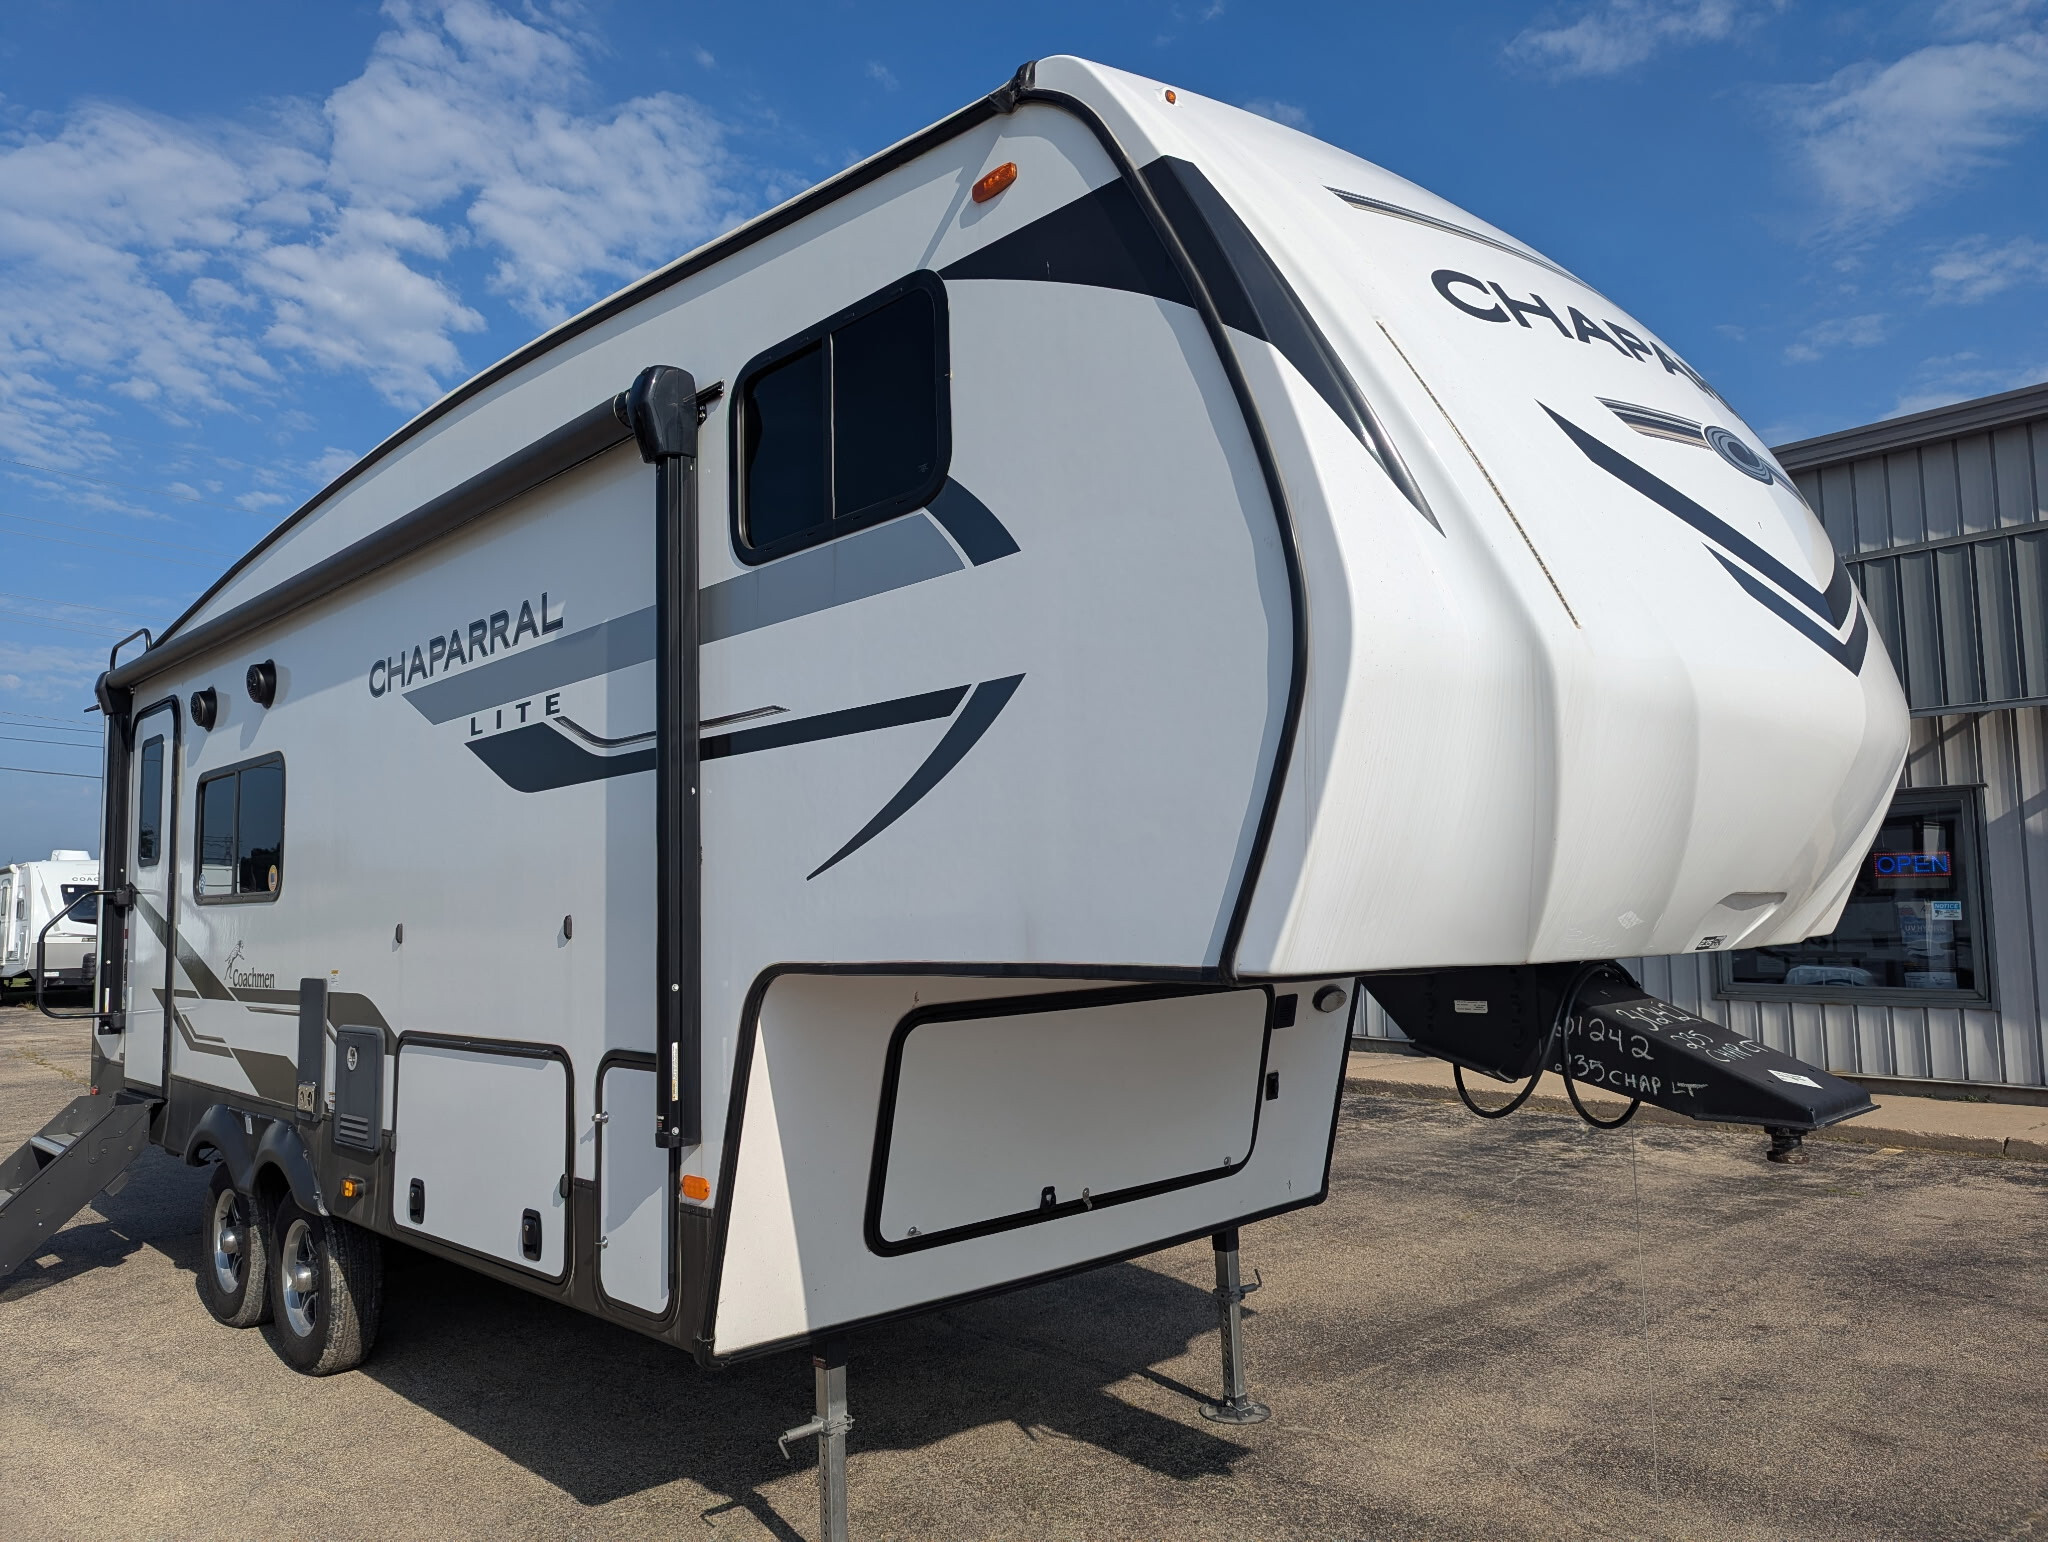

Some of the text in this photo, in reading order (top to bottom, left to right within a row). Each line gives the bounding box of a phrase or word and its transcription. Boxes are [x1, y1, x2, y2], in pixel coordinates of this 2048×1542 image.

[1431, 268, 1741, 421] CHAPA
[368, 591, 564, 698] CHAPARRAL
[470, 692, 561, 736] LITE
[1877, 855, 1947, 873] OPEN
[232, 966, 275, 988] Coachmen
[1670, 1030, 1714, 1049] 235
[1609, 1070, 1661, 1096] CHAP
[1672, 1081, 1709, 1097] LT
